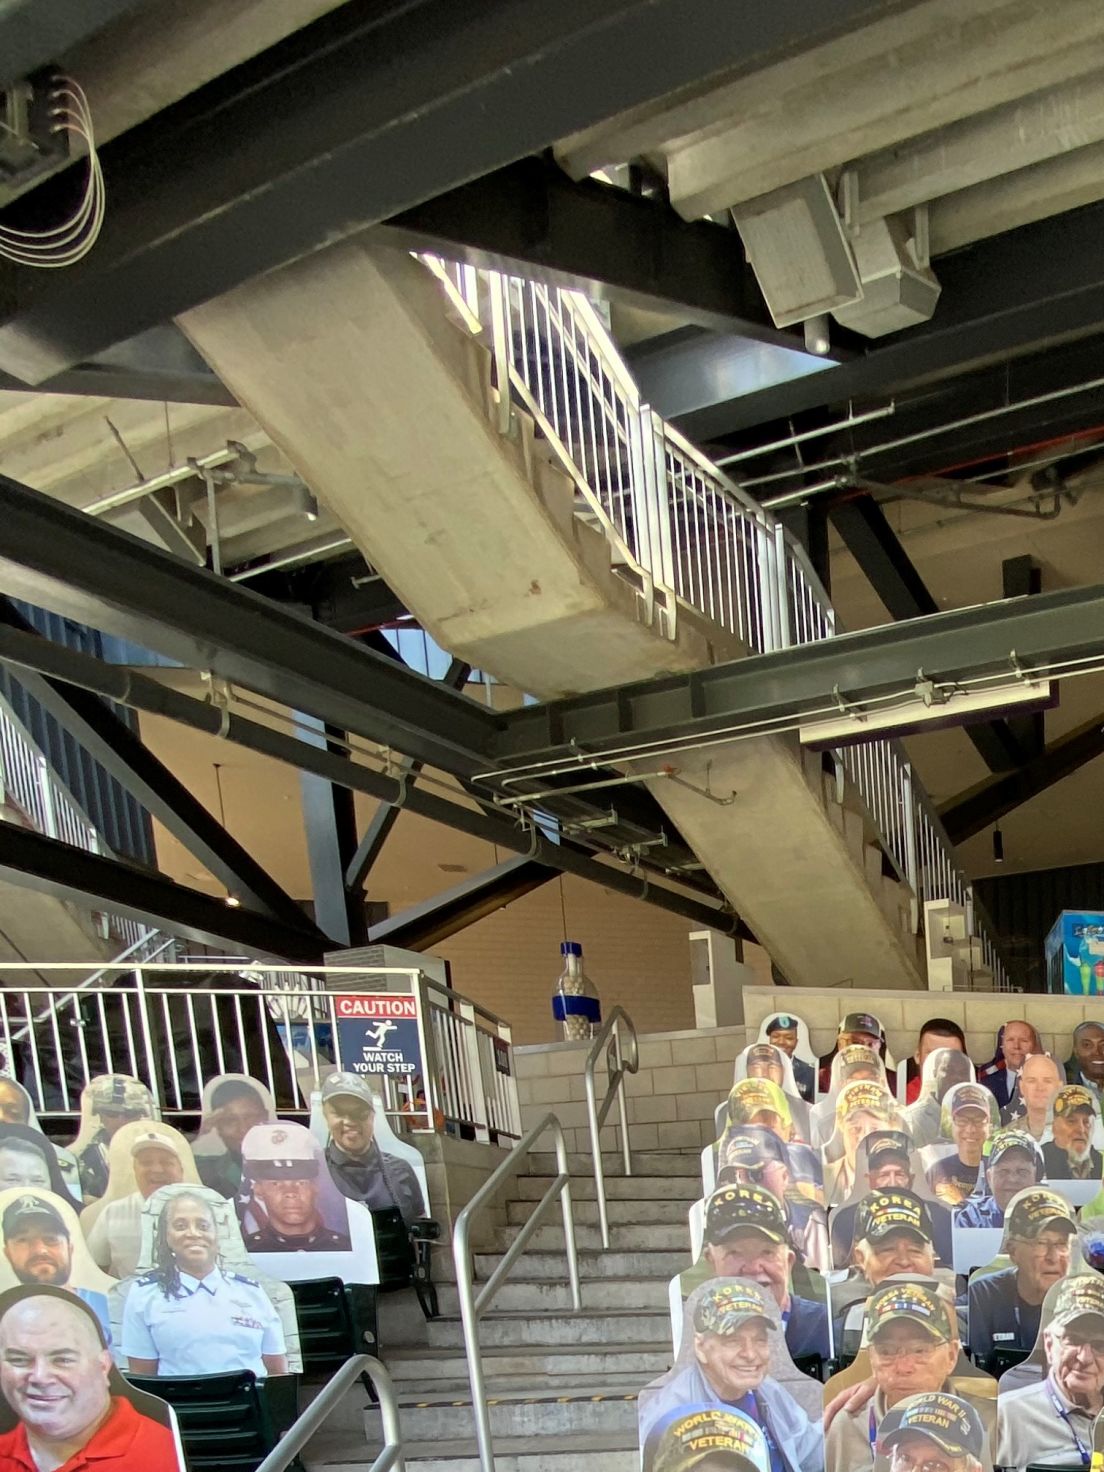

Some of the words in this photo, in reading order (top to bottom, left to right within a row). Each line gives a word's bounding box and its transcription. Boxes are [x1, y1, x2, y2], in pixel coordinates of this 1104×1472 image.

[340, 1000, 416, 1015] CAUTION
[363, 1053, 403, 1062] WATCH
[353, 1063, 384, 1072] YOUR
[387, 1063, 415, 1073] STEP
[715, 1190, 774, 1213] KOREA
[870, 1195, 921, 1214] KOREA
[873, 1213, 921, 1227] VETERAN
[937, 1396, 961, 1412] WAR
[673, 1411, 721, 1437] WORLD
[908, 1413, 950, 1429] VETERAN
[688, 1435, 749, 1452] VETERAN
